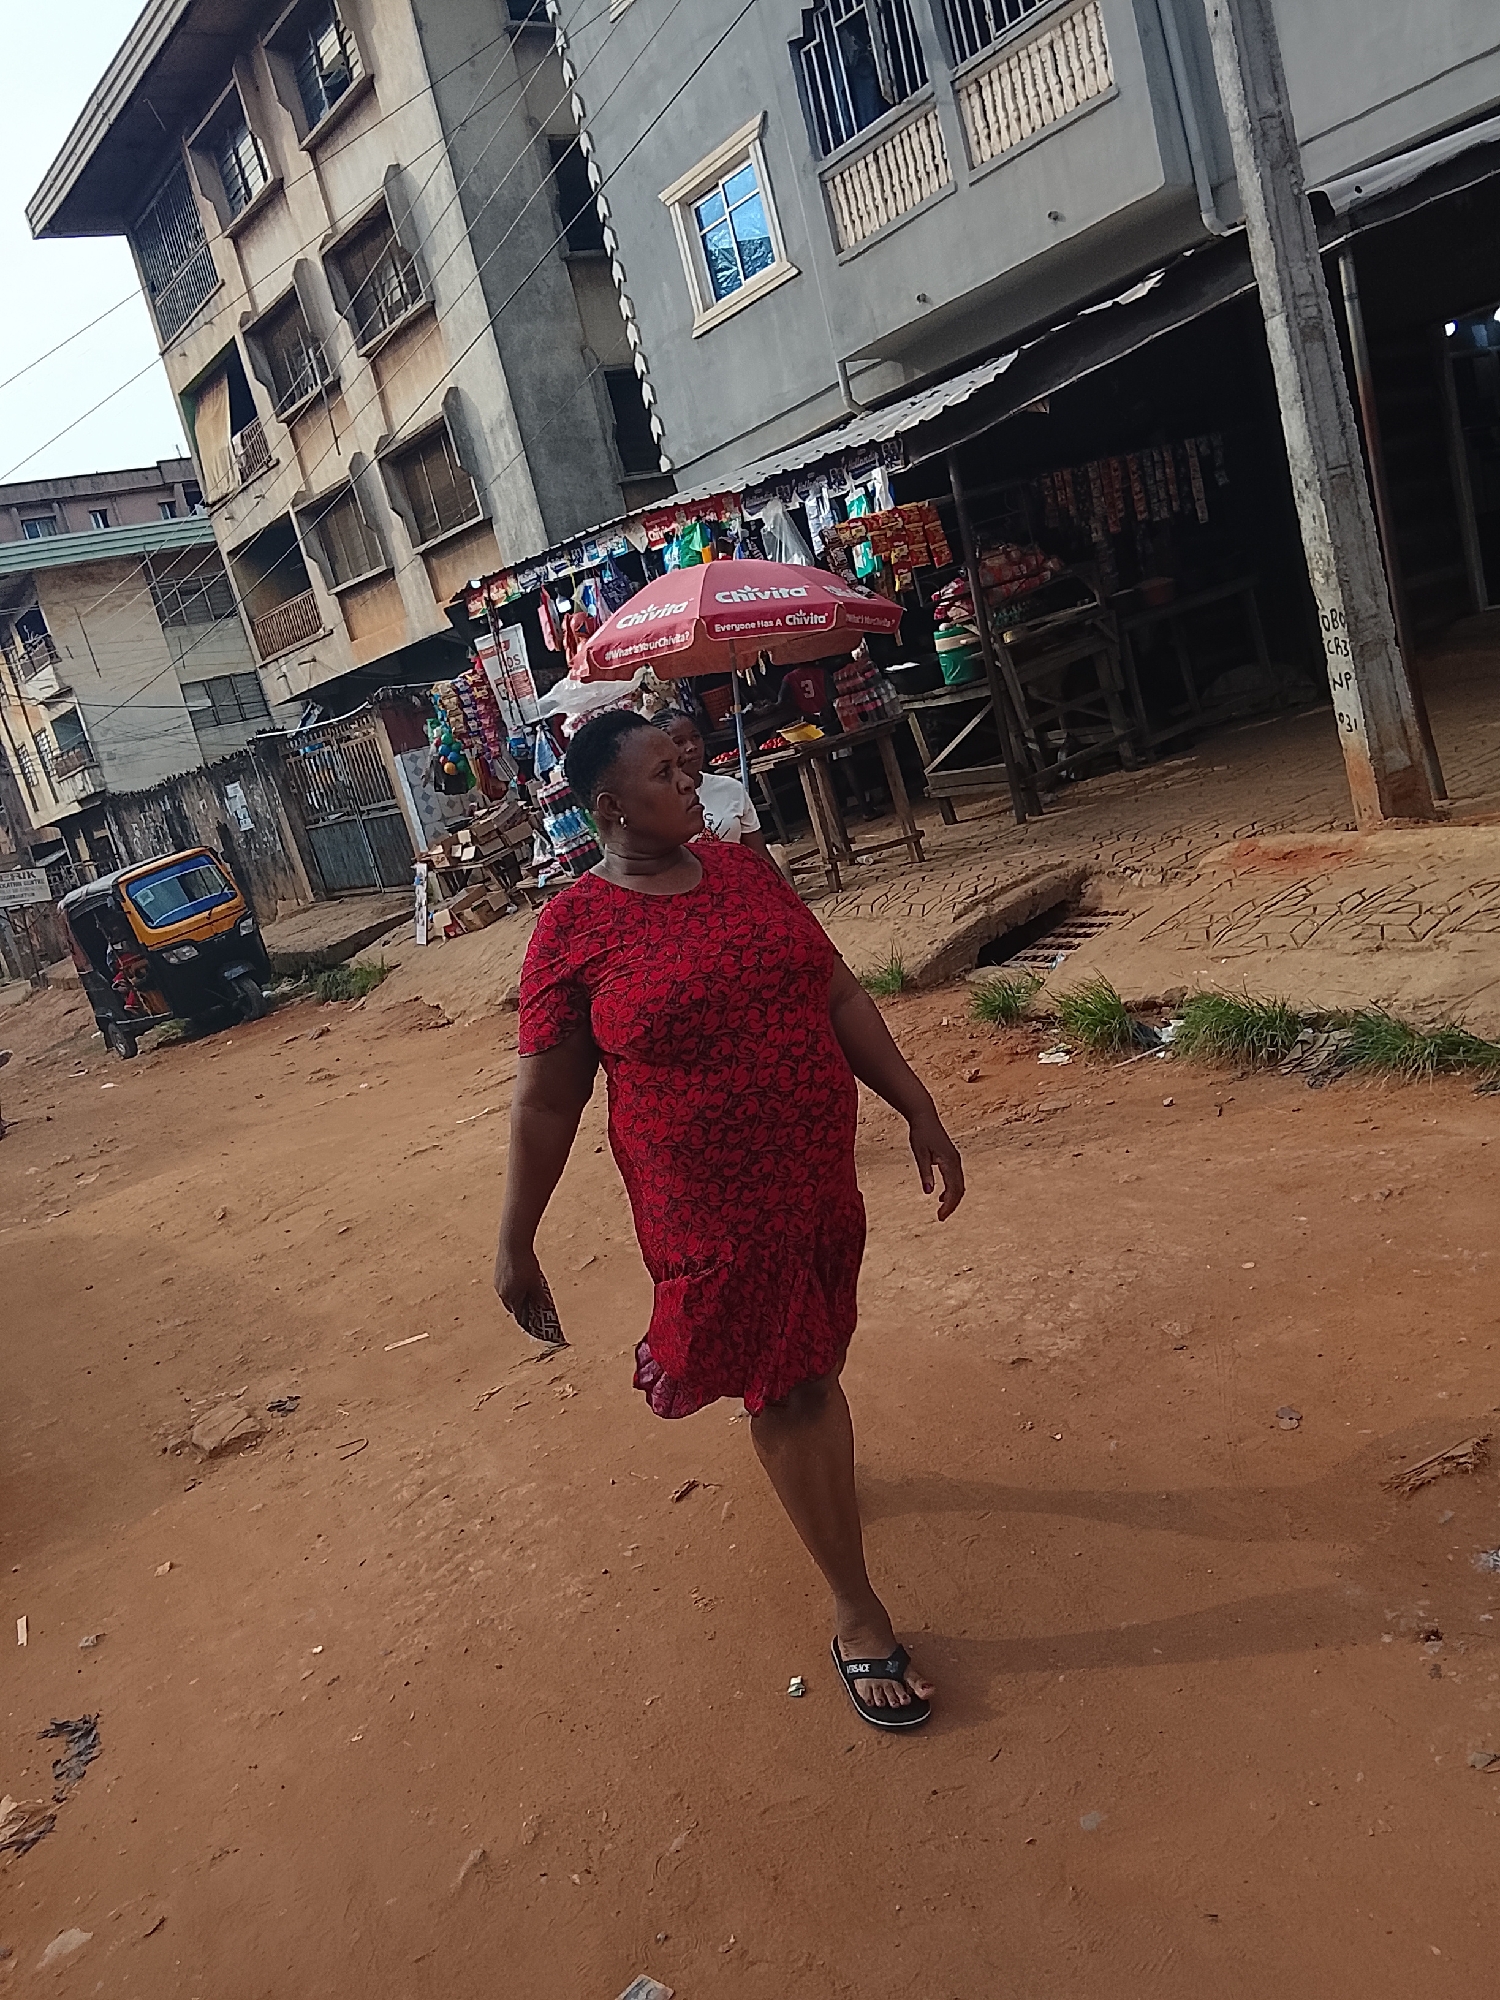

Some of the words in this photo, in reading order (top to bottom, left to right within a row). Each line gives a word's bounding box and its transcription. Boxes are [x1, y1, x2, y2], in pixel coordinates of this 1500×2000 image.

[715, 585, 807, 603] Chivita
[616, 601, 688, 629] Chivita
[715, 622, 756, 632] Everyone
[757, 620, 773, 628] Has
[775, 618, 782, 627] A
[786, 609, 826, 626] Chivita
[800, 679, 815, 699] 3
[1333, 672, 1352, 691] NP
